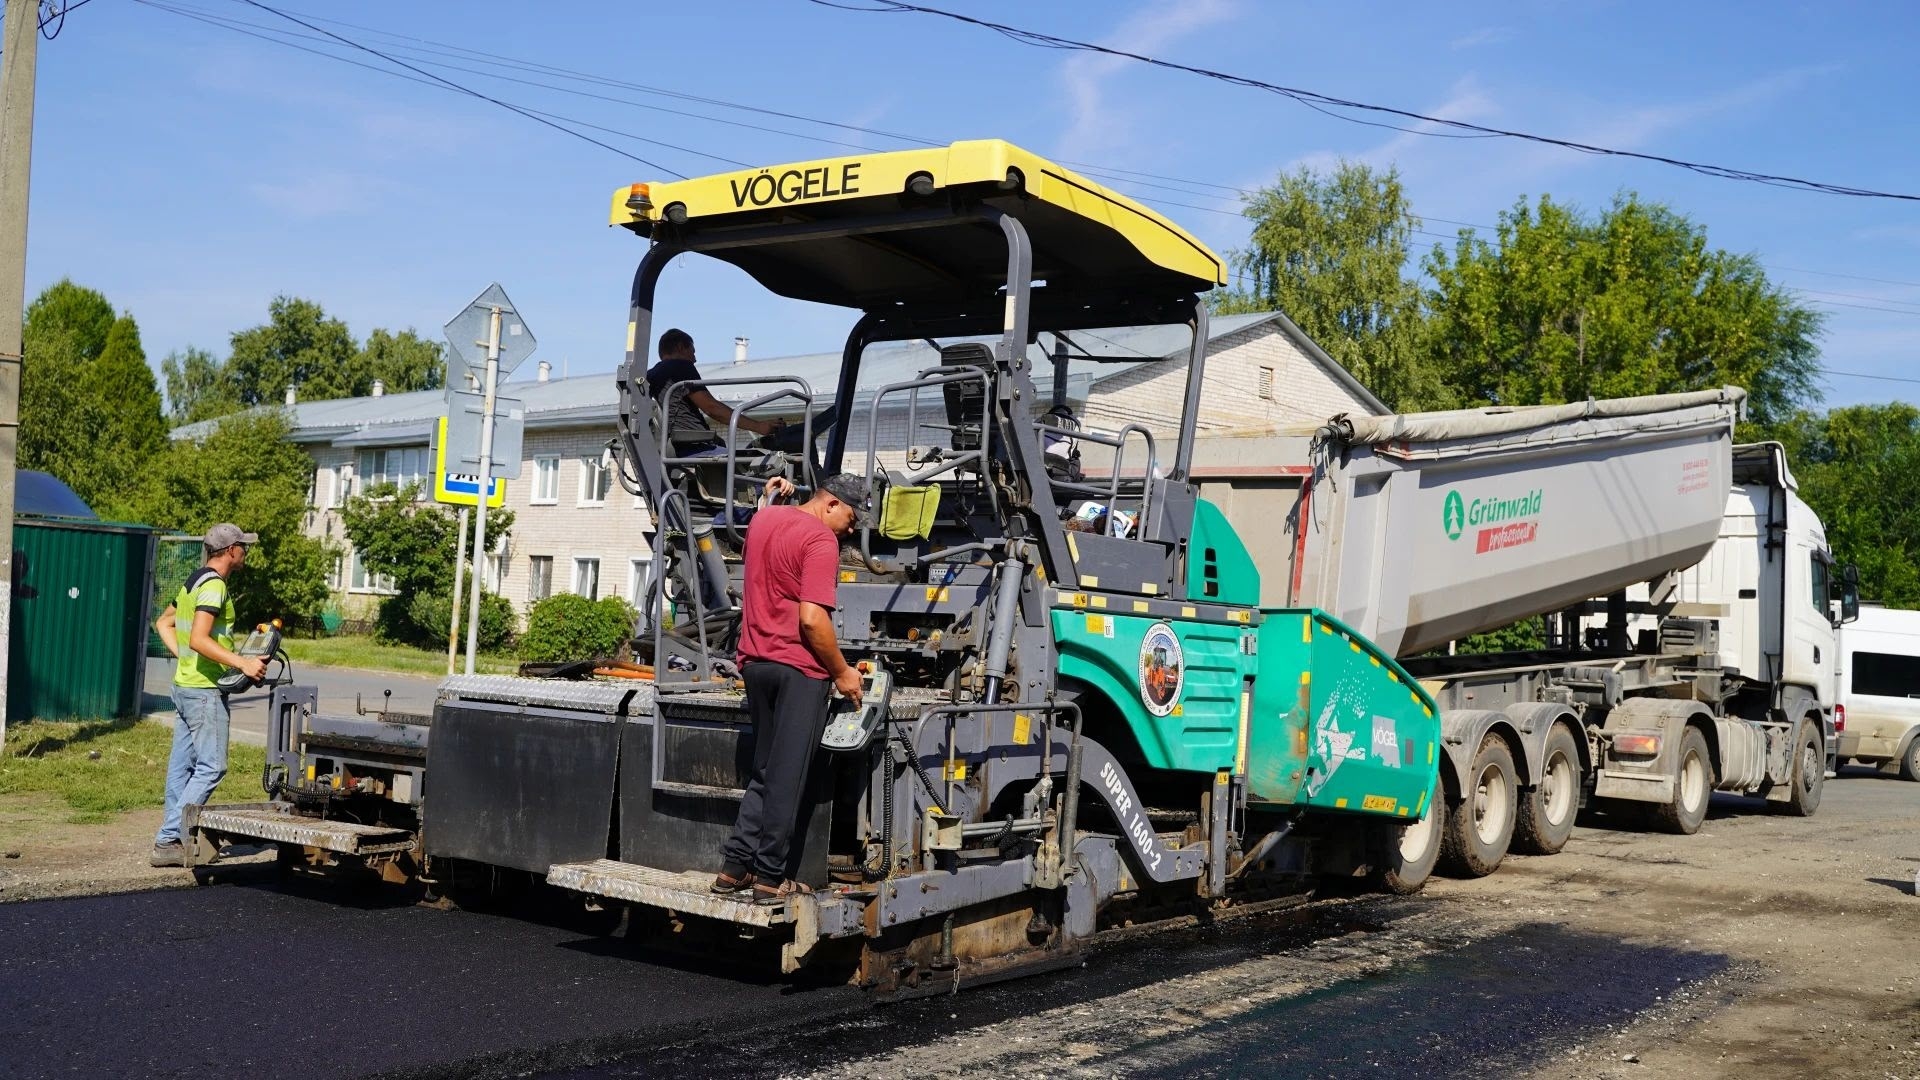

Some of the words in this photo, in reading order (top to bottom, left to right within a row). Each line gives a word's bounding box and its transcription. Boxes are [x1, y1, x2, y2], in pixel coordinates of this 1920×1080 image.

[730, 163, 861, 208] VÖGELE
[1469, 488, 1542, 525] Grünwald
[1100, 761, 1132, 818] SUPER
[1129, 812, 1162, 871] 1600-2
